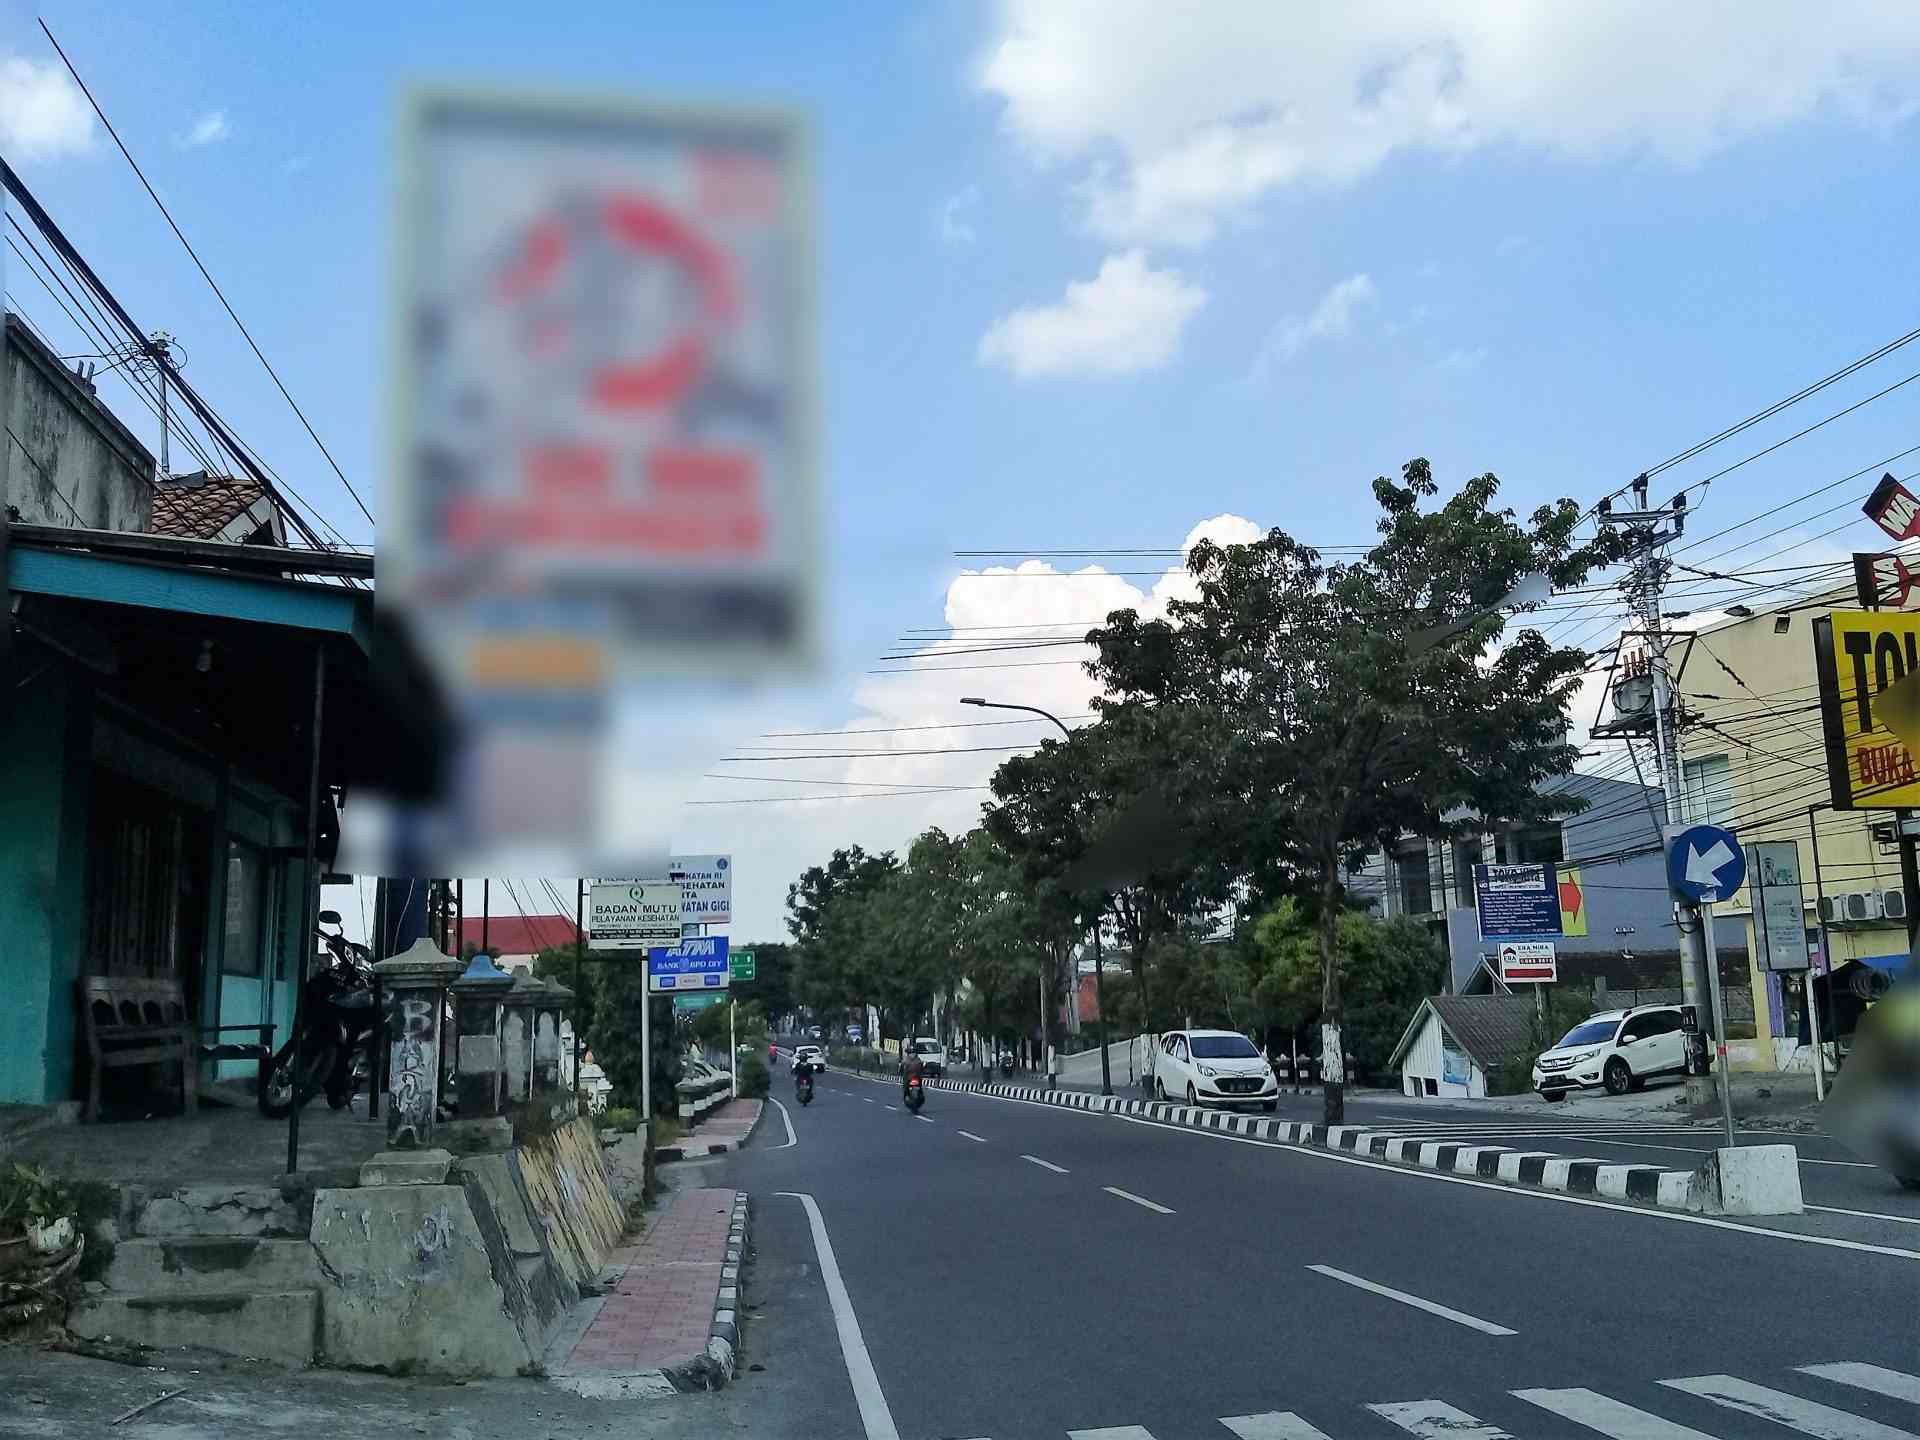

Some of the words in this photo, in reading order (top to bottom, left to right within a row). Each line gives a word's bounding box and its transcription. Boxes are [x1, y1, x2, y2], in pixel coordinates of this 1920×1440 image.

[1843, 631, 1919, 733] TO
[1857, 747, 1915, 785] BUKA
[595, 904, 637, 914] BADAN
[643, 904, 677, 914] MUTU
[711, 900, 730, 912] GIGI
[665, 940, 715, 957] ATM
[657, 961, 679, 969] BANK
[689, 961, 706, 969] BPD
